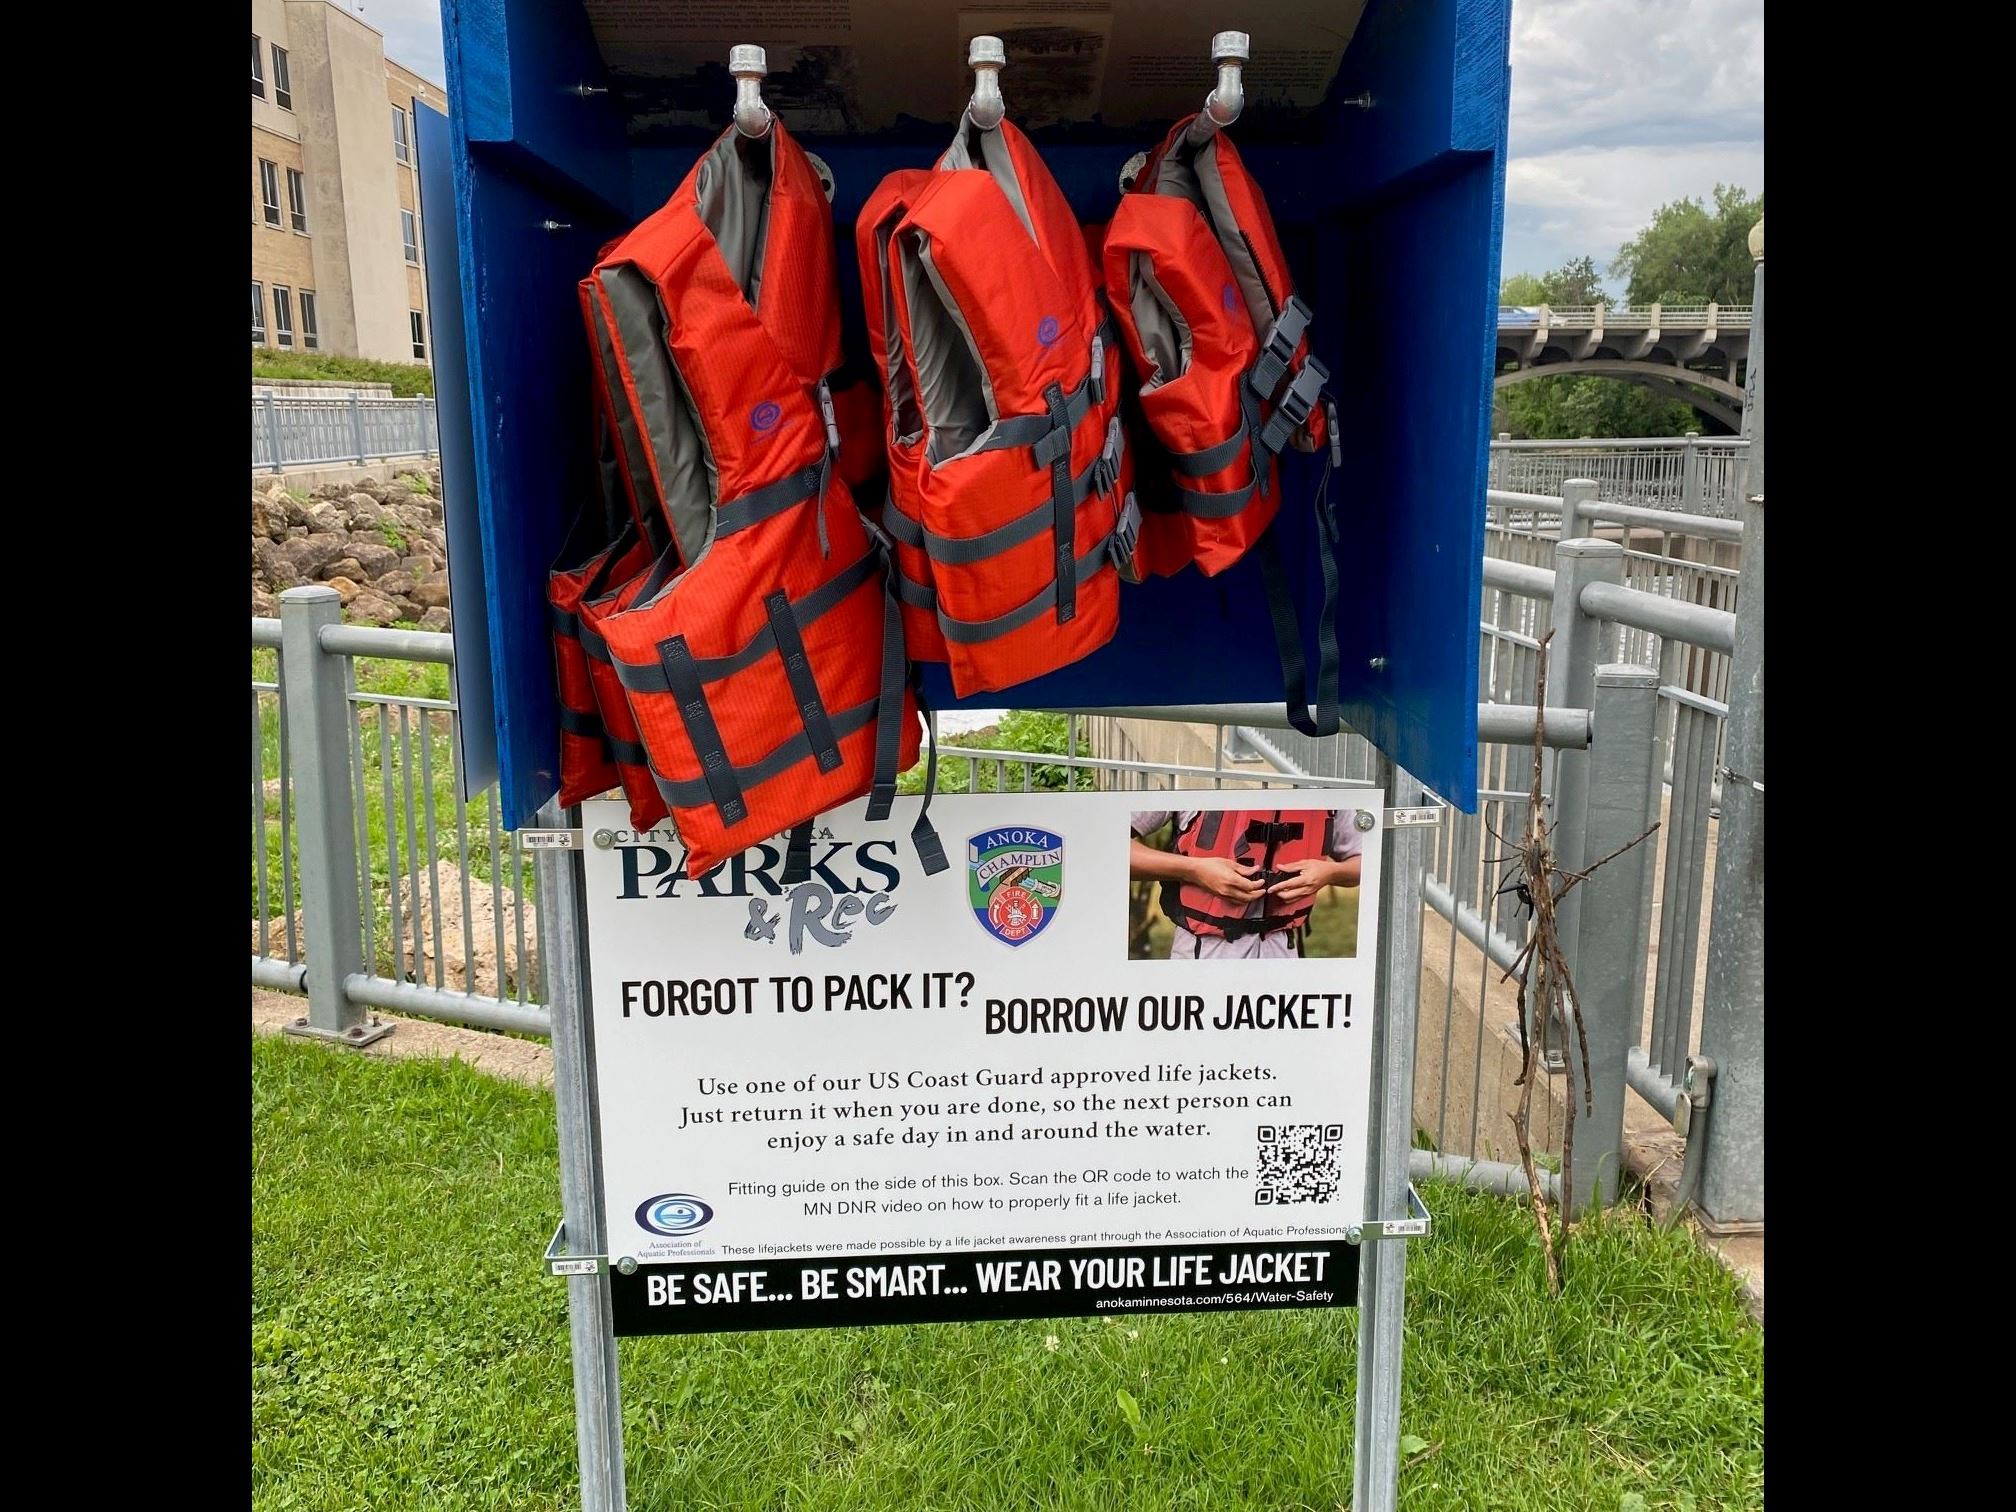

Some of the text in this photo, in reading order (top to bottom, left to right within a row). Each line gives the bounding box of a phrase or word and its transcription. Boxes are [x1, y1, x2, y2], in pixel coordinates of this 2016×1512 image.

[614, 829, 677, 843] CITY
[986, 830, 1049, 850] ANOKA
[979, 851, 1061, 880] CHAMPLIN
[1005, 890, 1027, 899] FIRE
[743, 897, 782, 944] &
[622, 972, 975, 1017] FORGOT TO PACK IT?
[986, 994, 1351, 1034] BORROW OUR JACKET!
[697, 1063, 1277, 1096] Use one of our US Coast Guard approved life jackets.
[677, 1093, 1292, 1130] Just return it when you are done, so the next person can
[767, 1120, 1211, 1153] enjoy a safe day in and around the water.
[728, 1166, 1249, 1198] Fitting guide on the side of this box. Scan the QR code to watch the
[804, 1191, 1181, 1216] MN DNR video on how to properly fit a life jacket.
[636, 1247, 716, 1259] Aquatic Professionals
[648, 1239, 702, 1250] Association of
[721, 1244, 755, 1255] These
[758, 1243, 813, 1256] lifejackets
[815, 1243, 843, 1252] were
[846, 1239, 877, 1251] made
[880, 1237, 926, 1252] possible
[929, 1237, 942, 1250] by
[944, 1239, 952, 1247] a
[955, 1236, 971, 1247] life
[973, 1235, 1006, 1249] jacket
[1008, 1235, 1067, 1245] awareness
[1069, 1232, 1097, 1245] grant
[1100, 1230, 1142, 1243] through
[1144, 1230, 1162, 1240] the
[1164, 1229, 1227, 1240] Association
[1229, 1227, 1241, 1238] of
[1242, 1227, 1284, 1239] Aquatic
[648, 1252, 1330, 1305] BE SAFE... BE SMART... WEAR YOUR LIFE JACKET
[1095, 1290, 1334, 1309] anokaminnesota.com/564/Water-Safety
